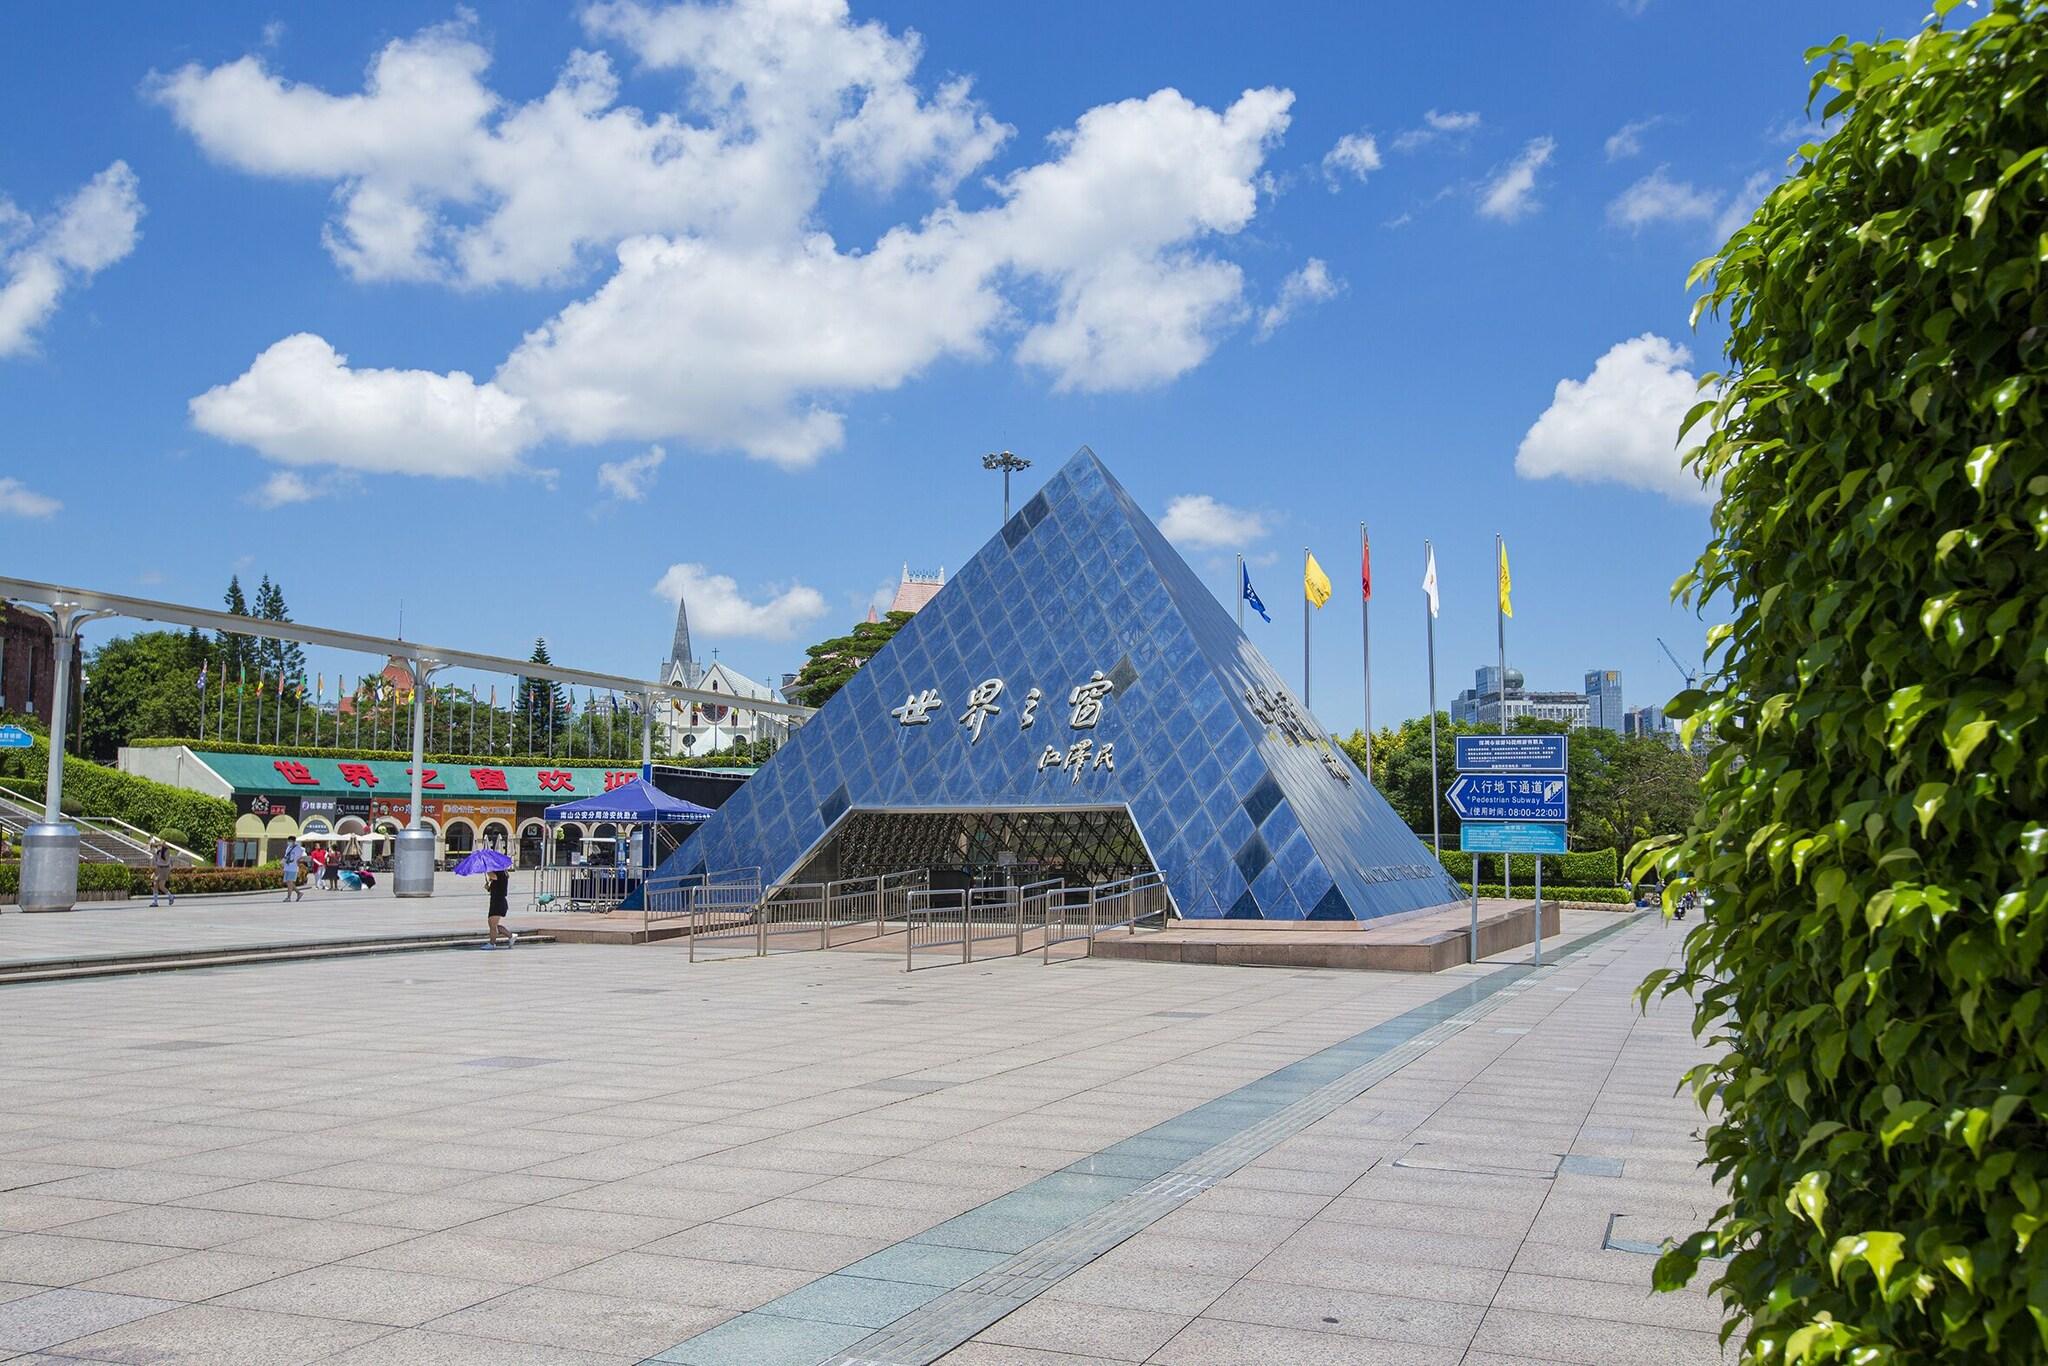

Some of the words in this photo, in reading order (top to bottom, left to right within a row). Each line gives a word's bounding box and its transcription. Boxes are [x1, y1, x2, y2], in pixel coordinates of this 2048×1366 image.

[891, 670, 1114, 745] 世界之窗
[1469, 780, 1542, 793] 人行地下通道
[1471, 795, 1510, 804] Pedestrian
[1511, 796, 1541, 806] Subway
